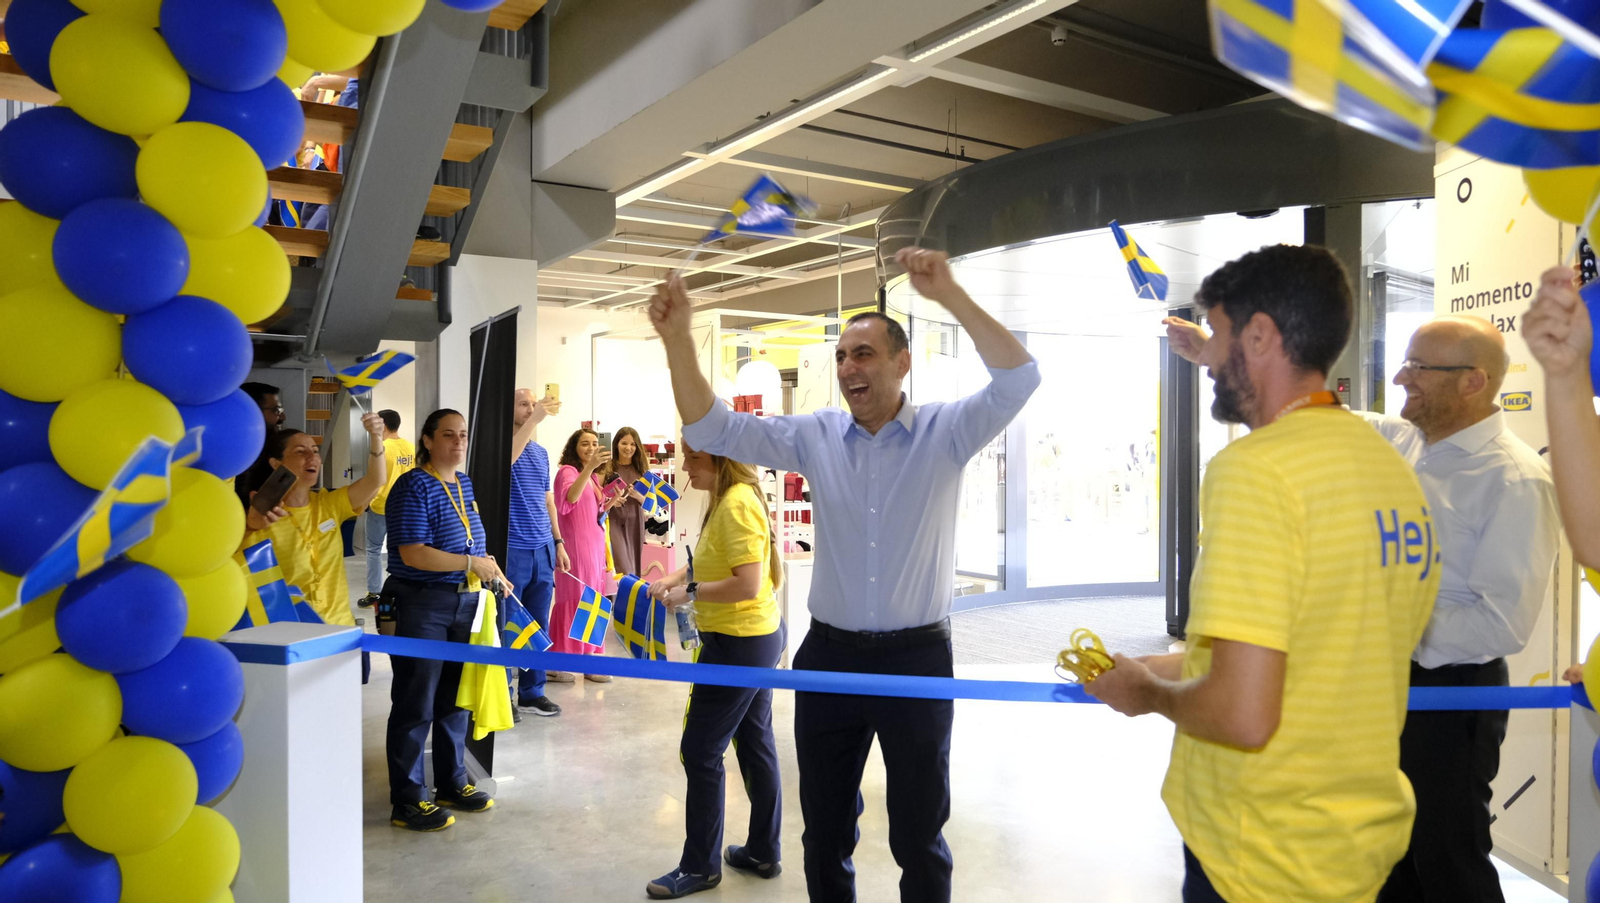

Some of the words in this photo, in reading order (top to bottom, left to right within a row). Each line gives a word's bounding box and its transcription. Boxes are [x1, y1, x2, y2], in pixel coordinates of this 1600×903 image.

[1451, 261, 1470, 285] Mi
[1450, 281, 1533, 313] momento
[1490, 313, 1517, 333] lax
[396, 454, 413, 467] Hej!
